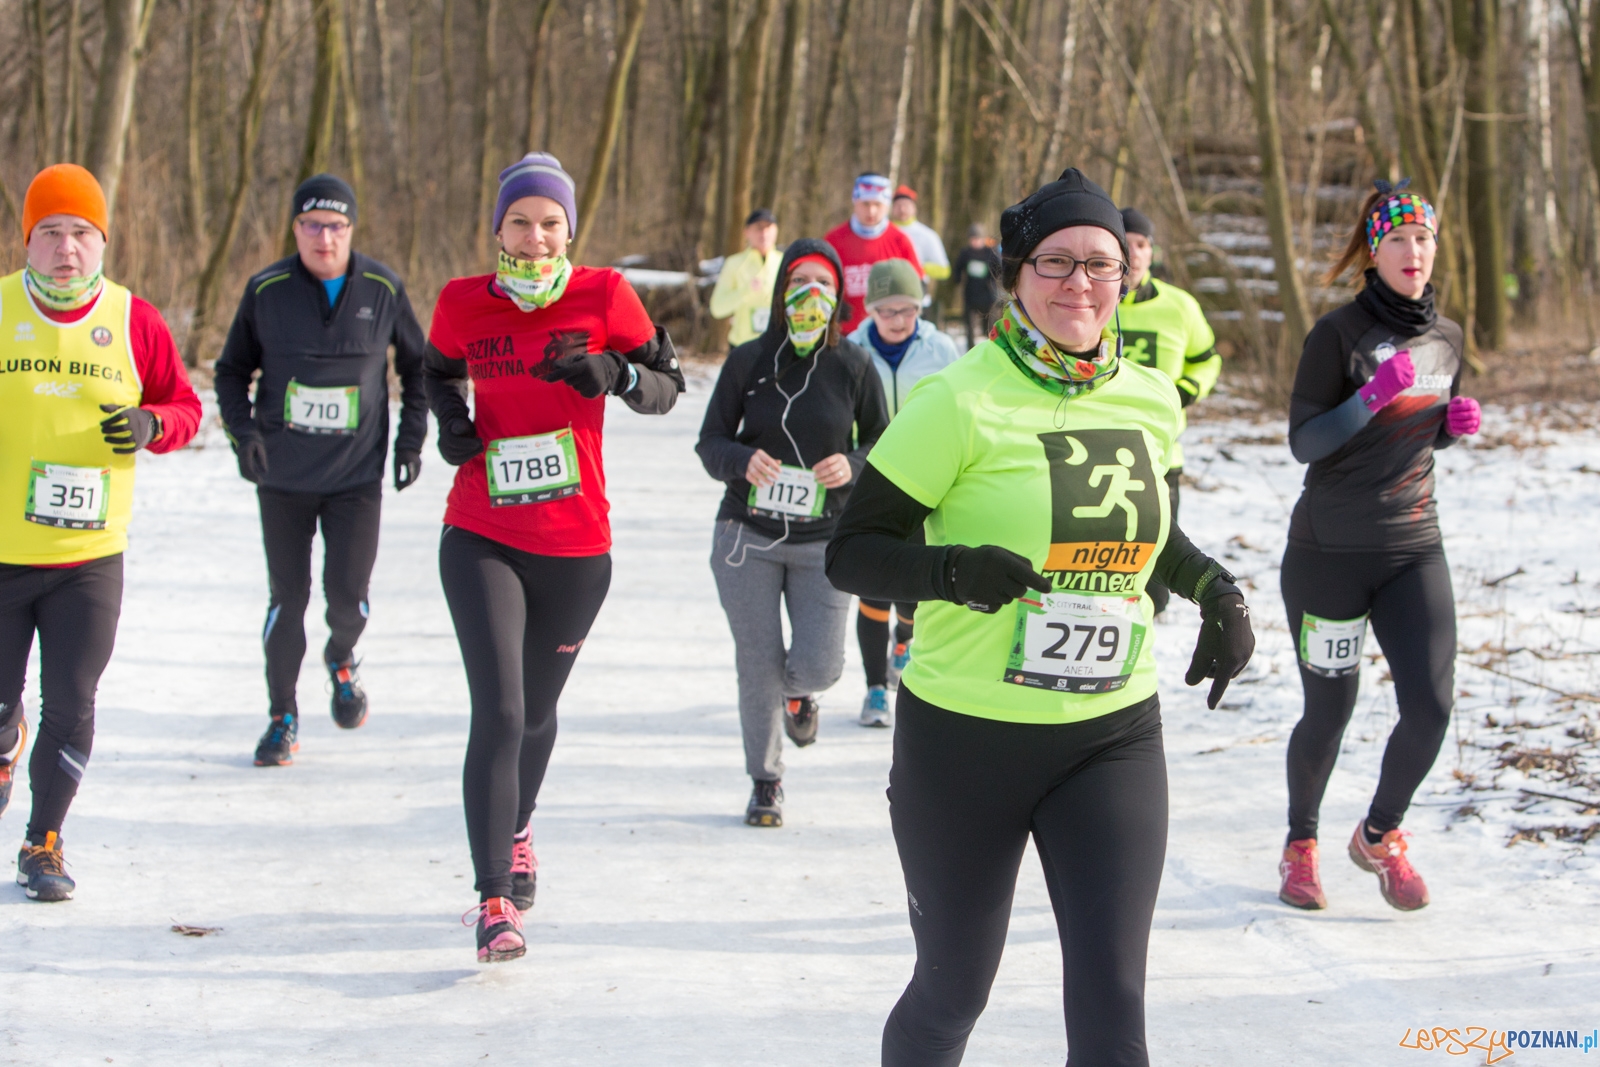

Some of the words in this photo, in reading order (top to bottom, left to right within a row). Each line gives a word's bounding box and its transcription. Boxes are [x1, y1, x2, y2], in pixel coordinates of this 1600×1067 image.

[69, 361, 123, 383] BIEGA
[303, 402, 340, 420] 710
[500, 454, 562, 483] 1788
[49, 484, 94, 509] 351
[769, 482, 809, 506] 1112
[1071, 542, 1140, 569] night
[1041, 622, 1119, 662] 279
[1324, 636, 1359, 659] 181
[1063, 665, 1094, 676] ANETA
